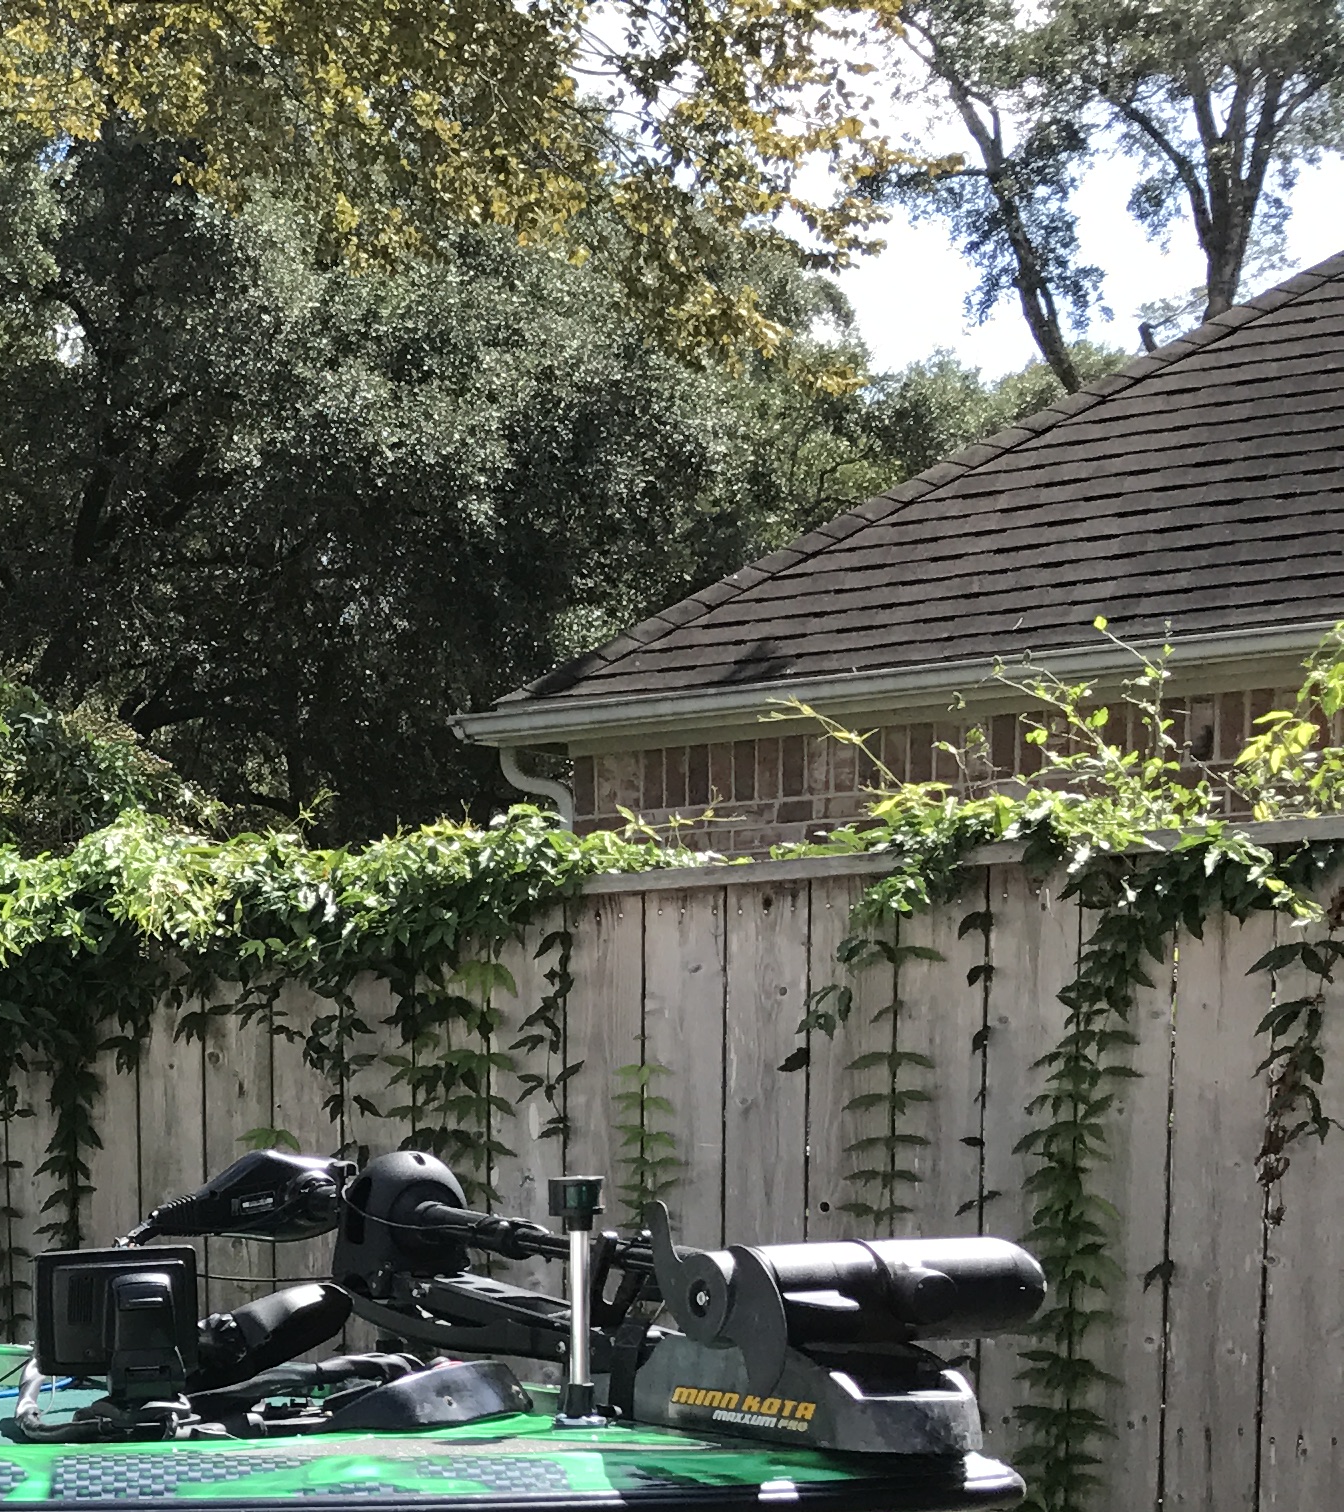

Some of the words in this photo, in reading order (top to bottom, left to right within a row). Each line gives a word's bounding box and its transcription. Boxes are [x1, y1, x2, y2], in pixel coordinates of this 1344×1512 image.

[671, 1387, 740, 1409] MINN
[741, 1395, 817, 1420] KOTA
[712, 1409, 778, 1428] MAXXUM
